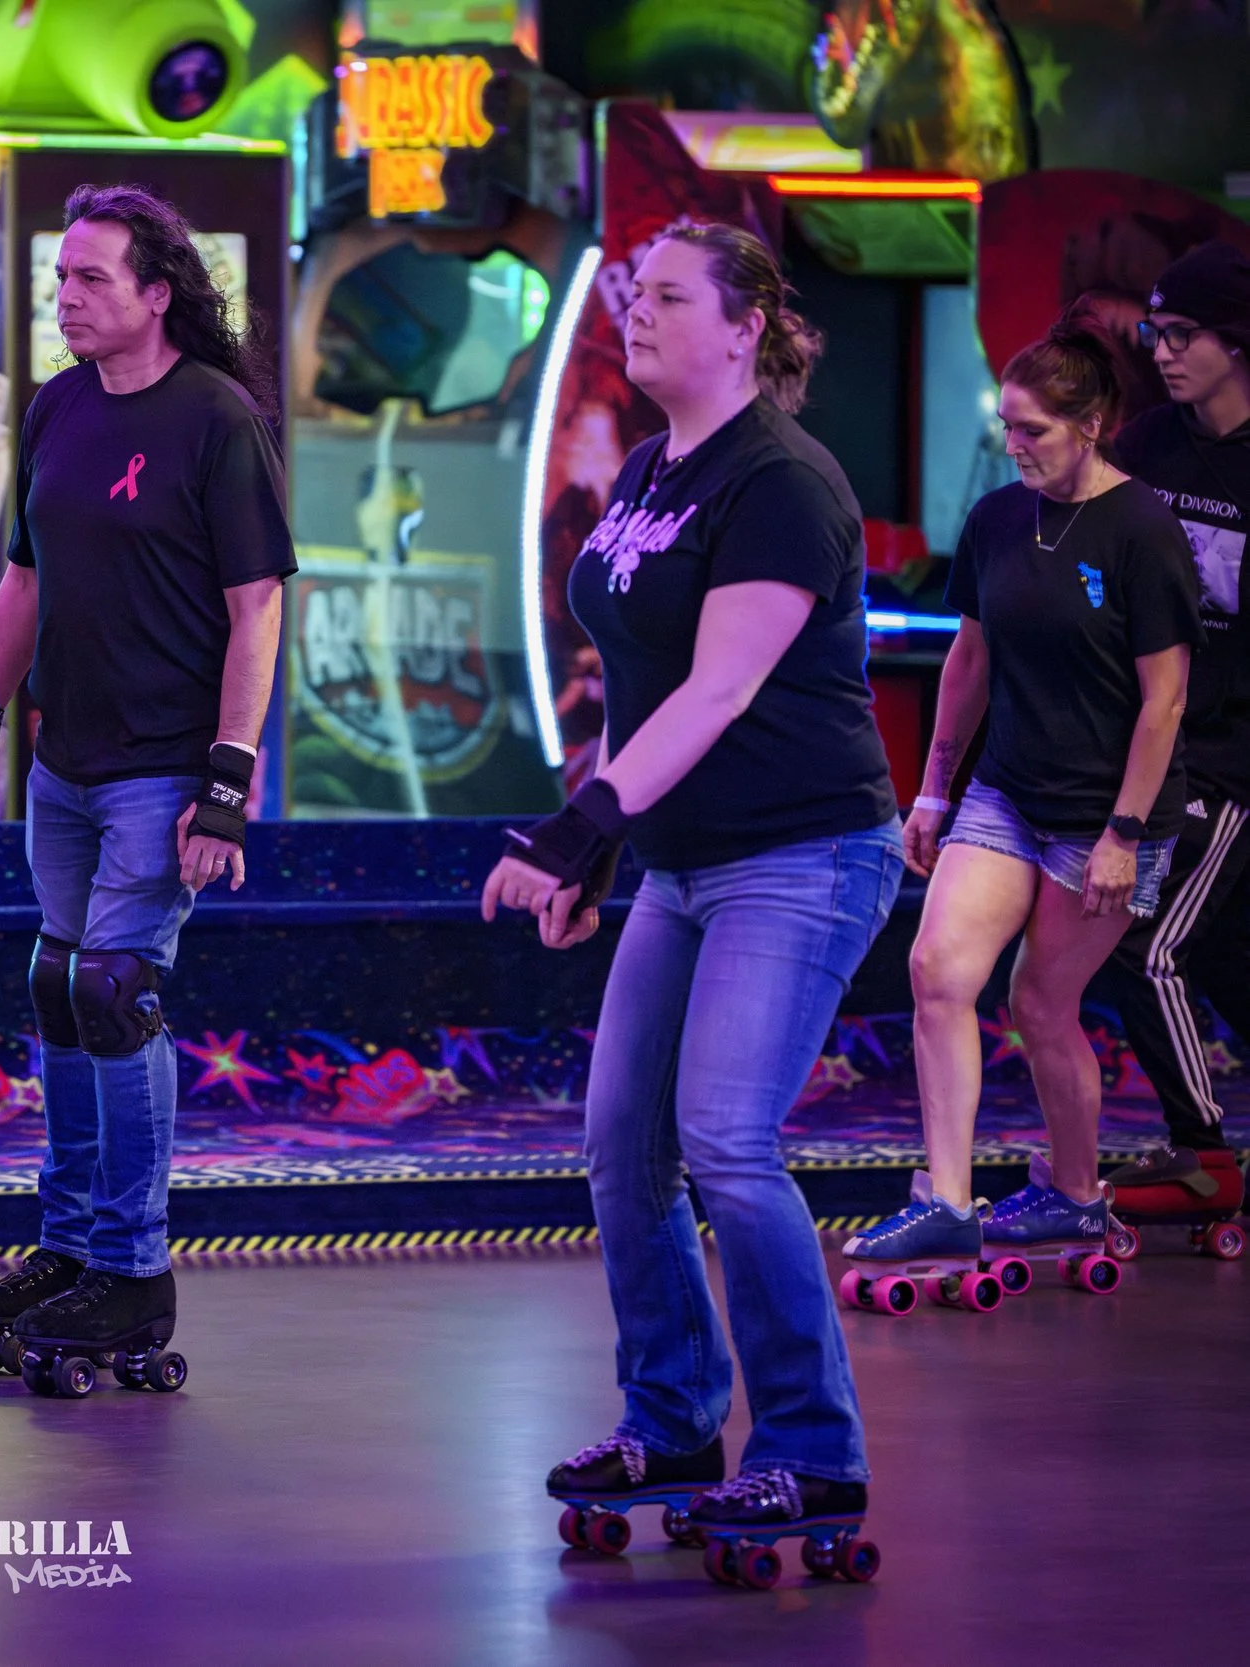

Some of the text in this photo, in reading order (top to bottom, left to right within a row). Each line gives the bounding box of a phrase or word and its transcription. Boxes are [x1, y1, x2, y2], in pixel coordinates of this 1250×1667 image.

[1154, 488, 1241, 520] OY DIVISION
[305, 585, 483, 699] ARADE
